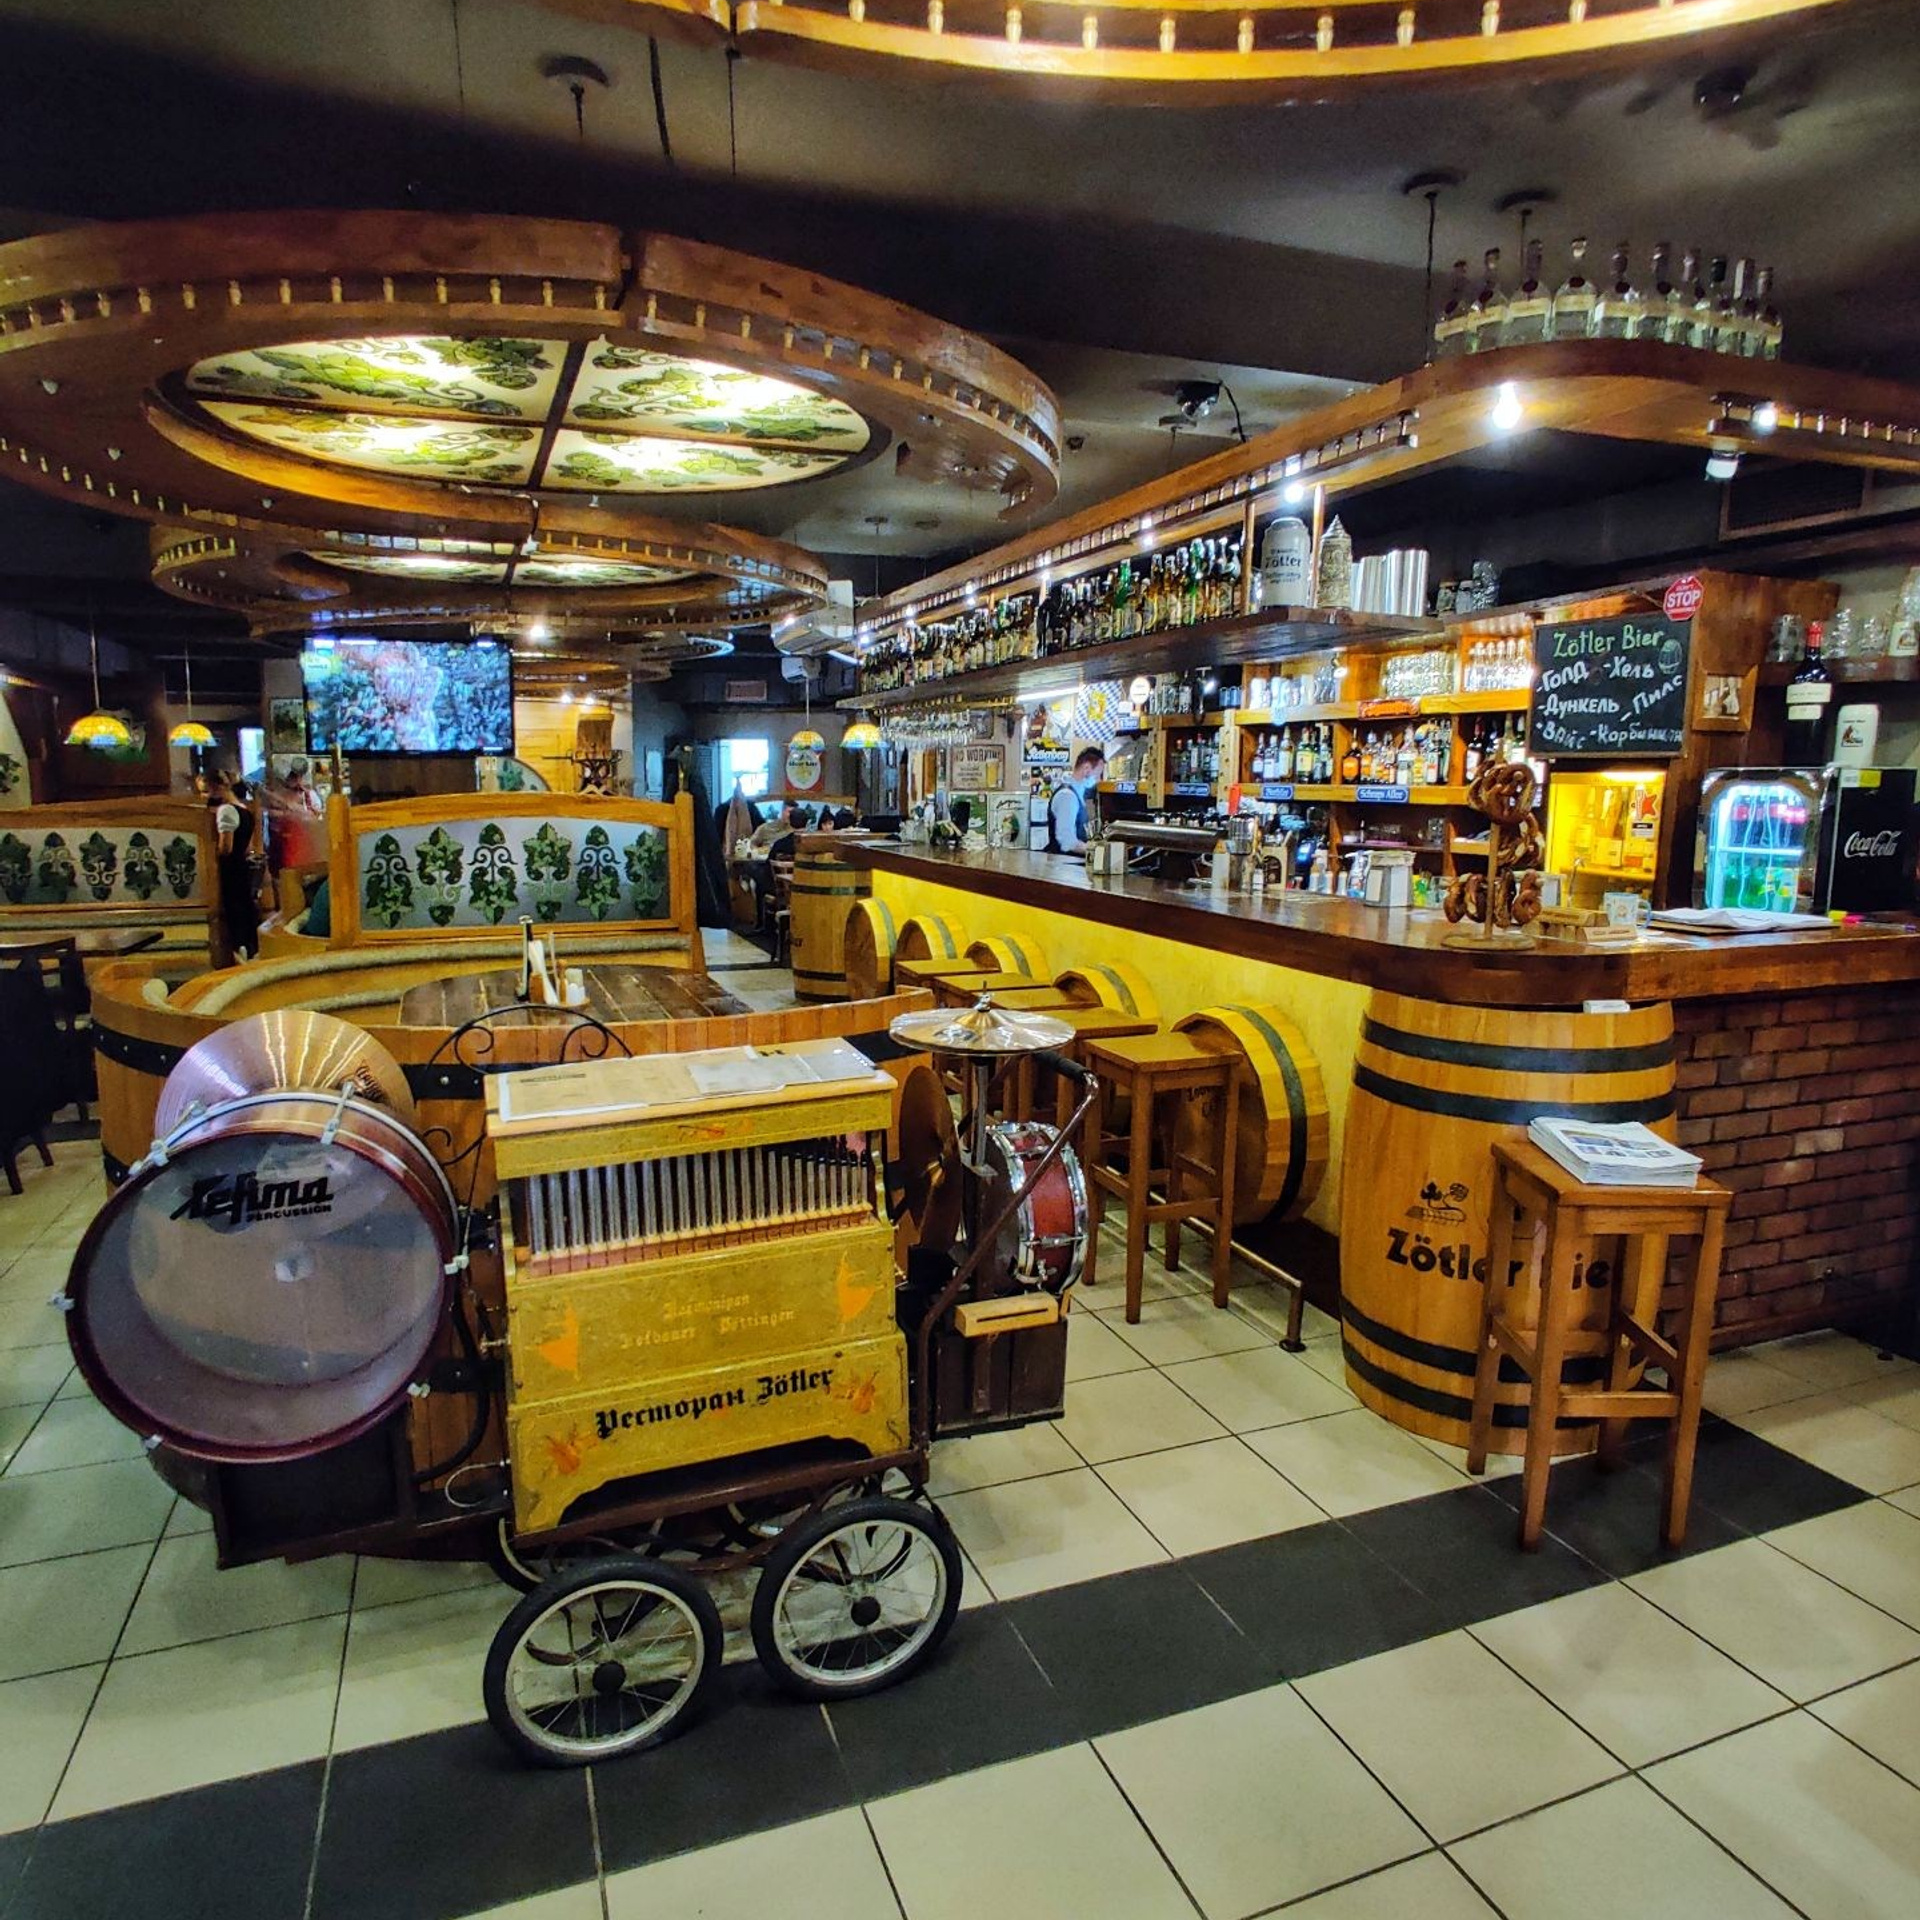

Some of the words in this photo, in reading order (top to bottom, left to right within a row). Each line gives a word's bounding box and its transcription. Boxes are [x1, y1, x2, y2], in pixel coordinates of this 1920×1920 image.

[1667, 590, 1702, 608] STOP
[1553, 629, 1616, 658] Zötler
[1621, 624, 1665, 651] Bier
[246, 1204, 332, 1223] PERCUSSION
